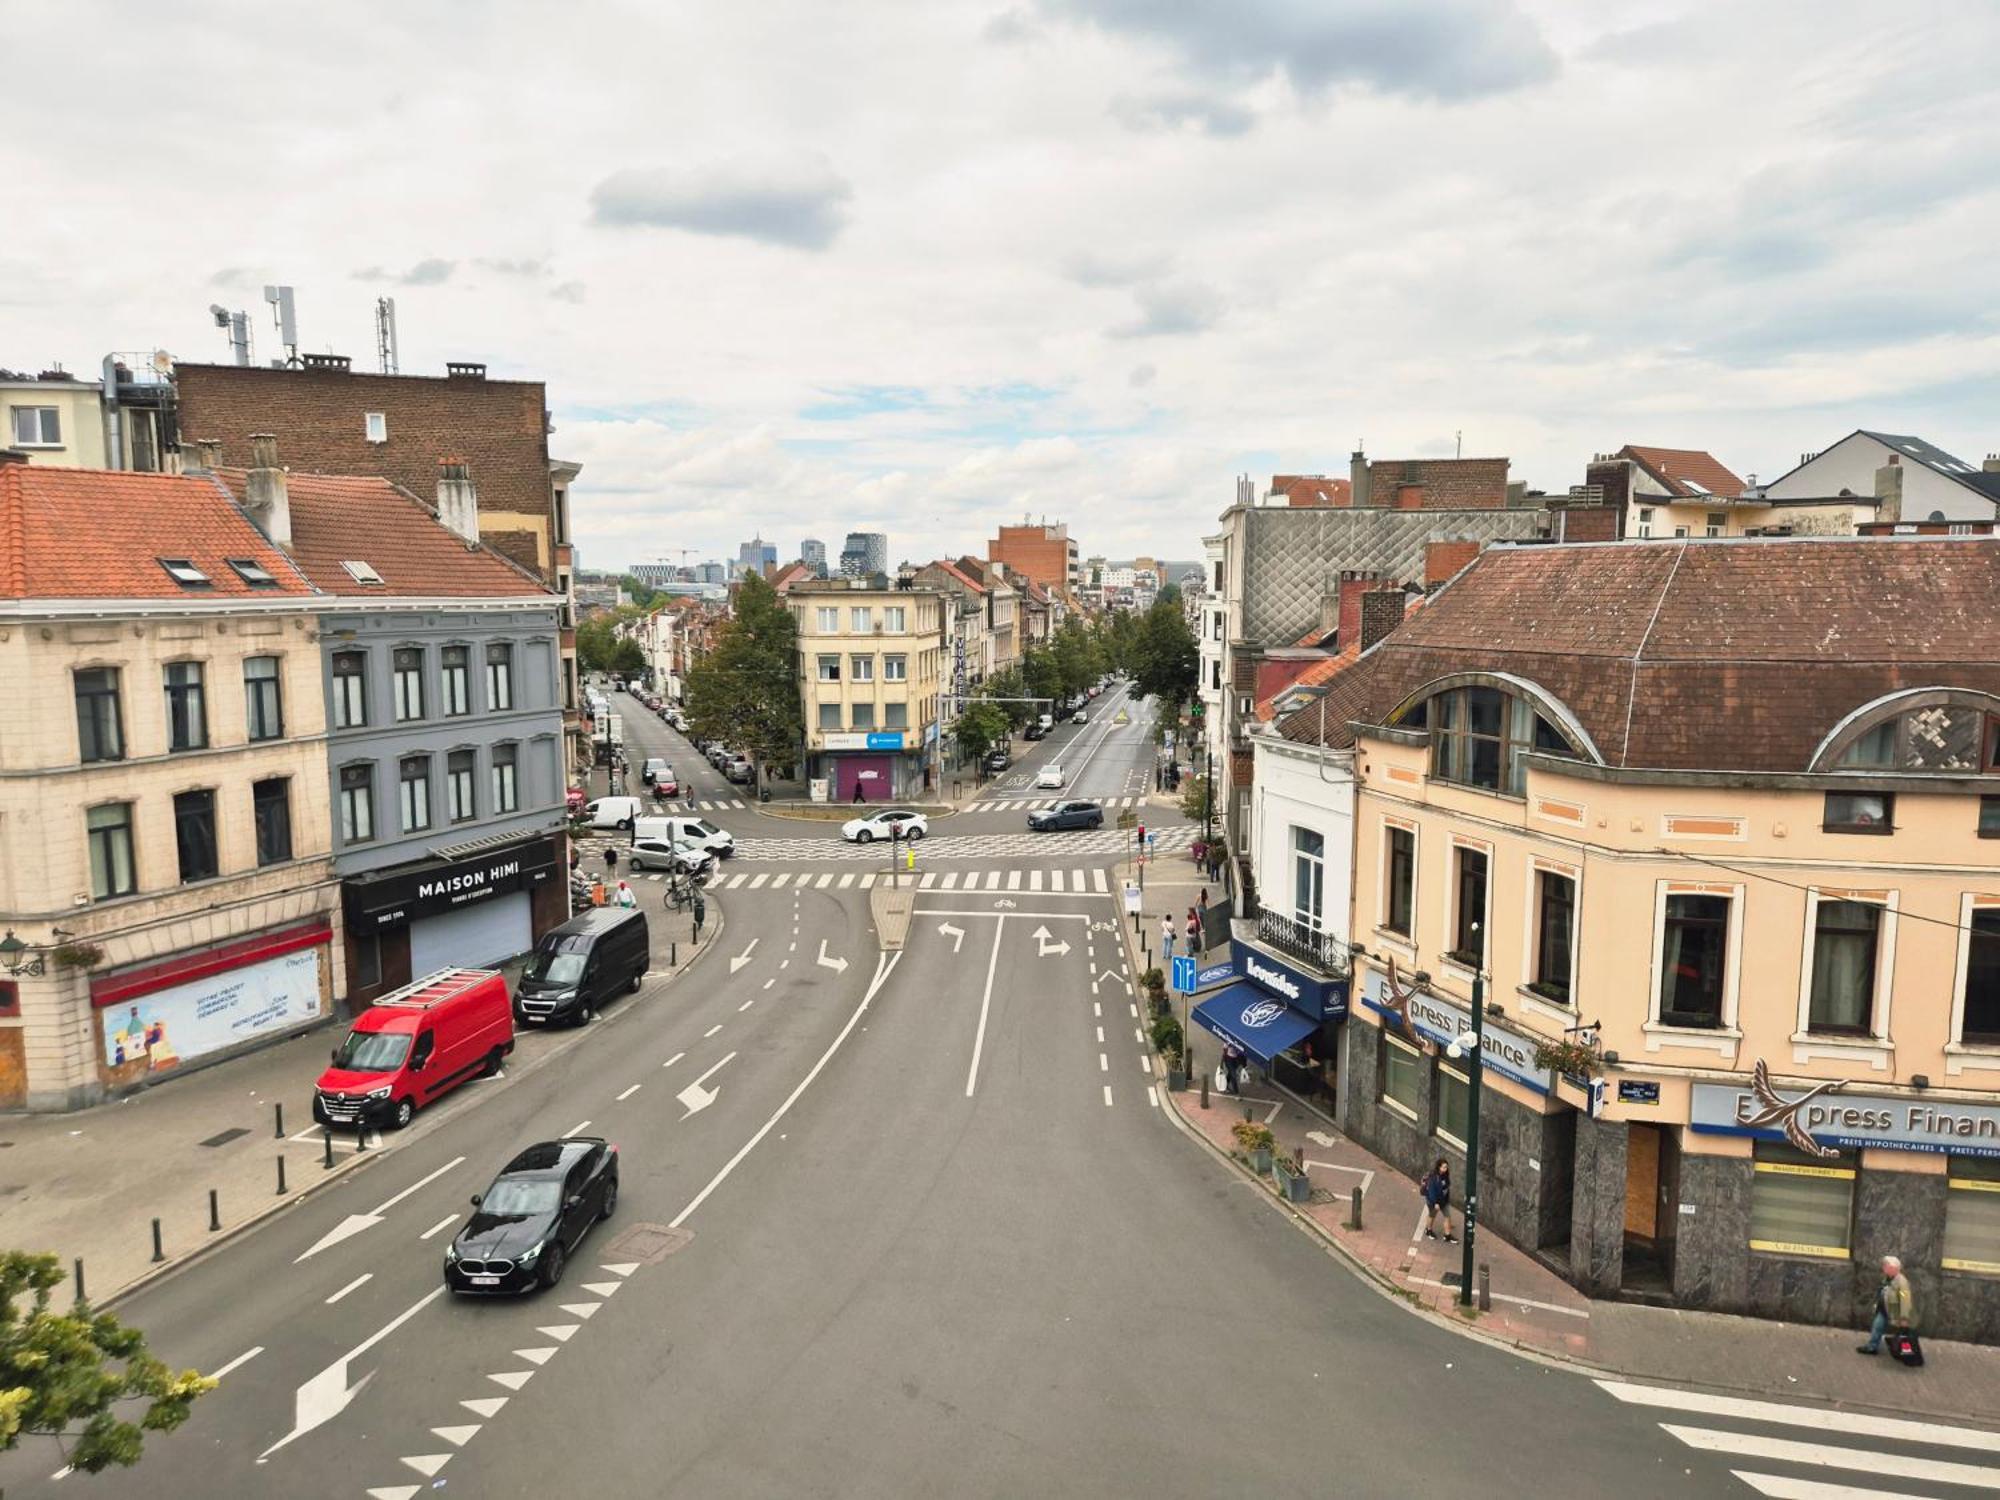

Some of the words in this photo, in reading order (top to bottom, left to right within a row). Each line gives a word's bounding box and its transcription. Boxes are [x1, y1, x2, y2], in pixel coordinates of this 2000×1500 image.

[419, 871, 484, 898] MAISON
[490, 861, 519, 880] HIMI
[1457, 1015, 1526, 1068] Fiance
[1906, 1106, 2000, 1137] Finan
